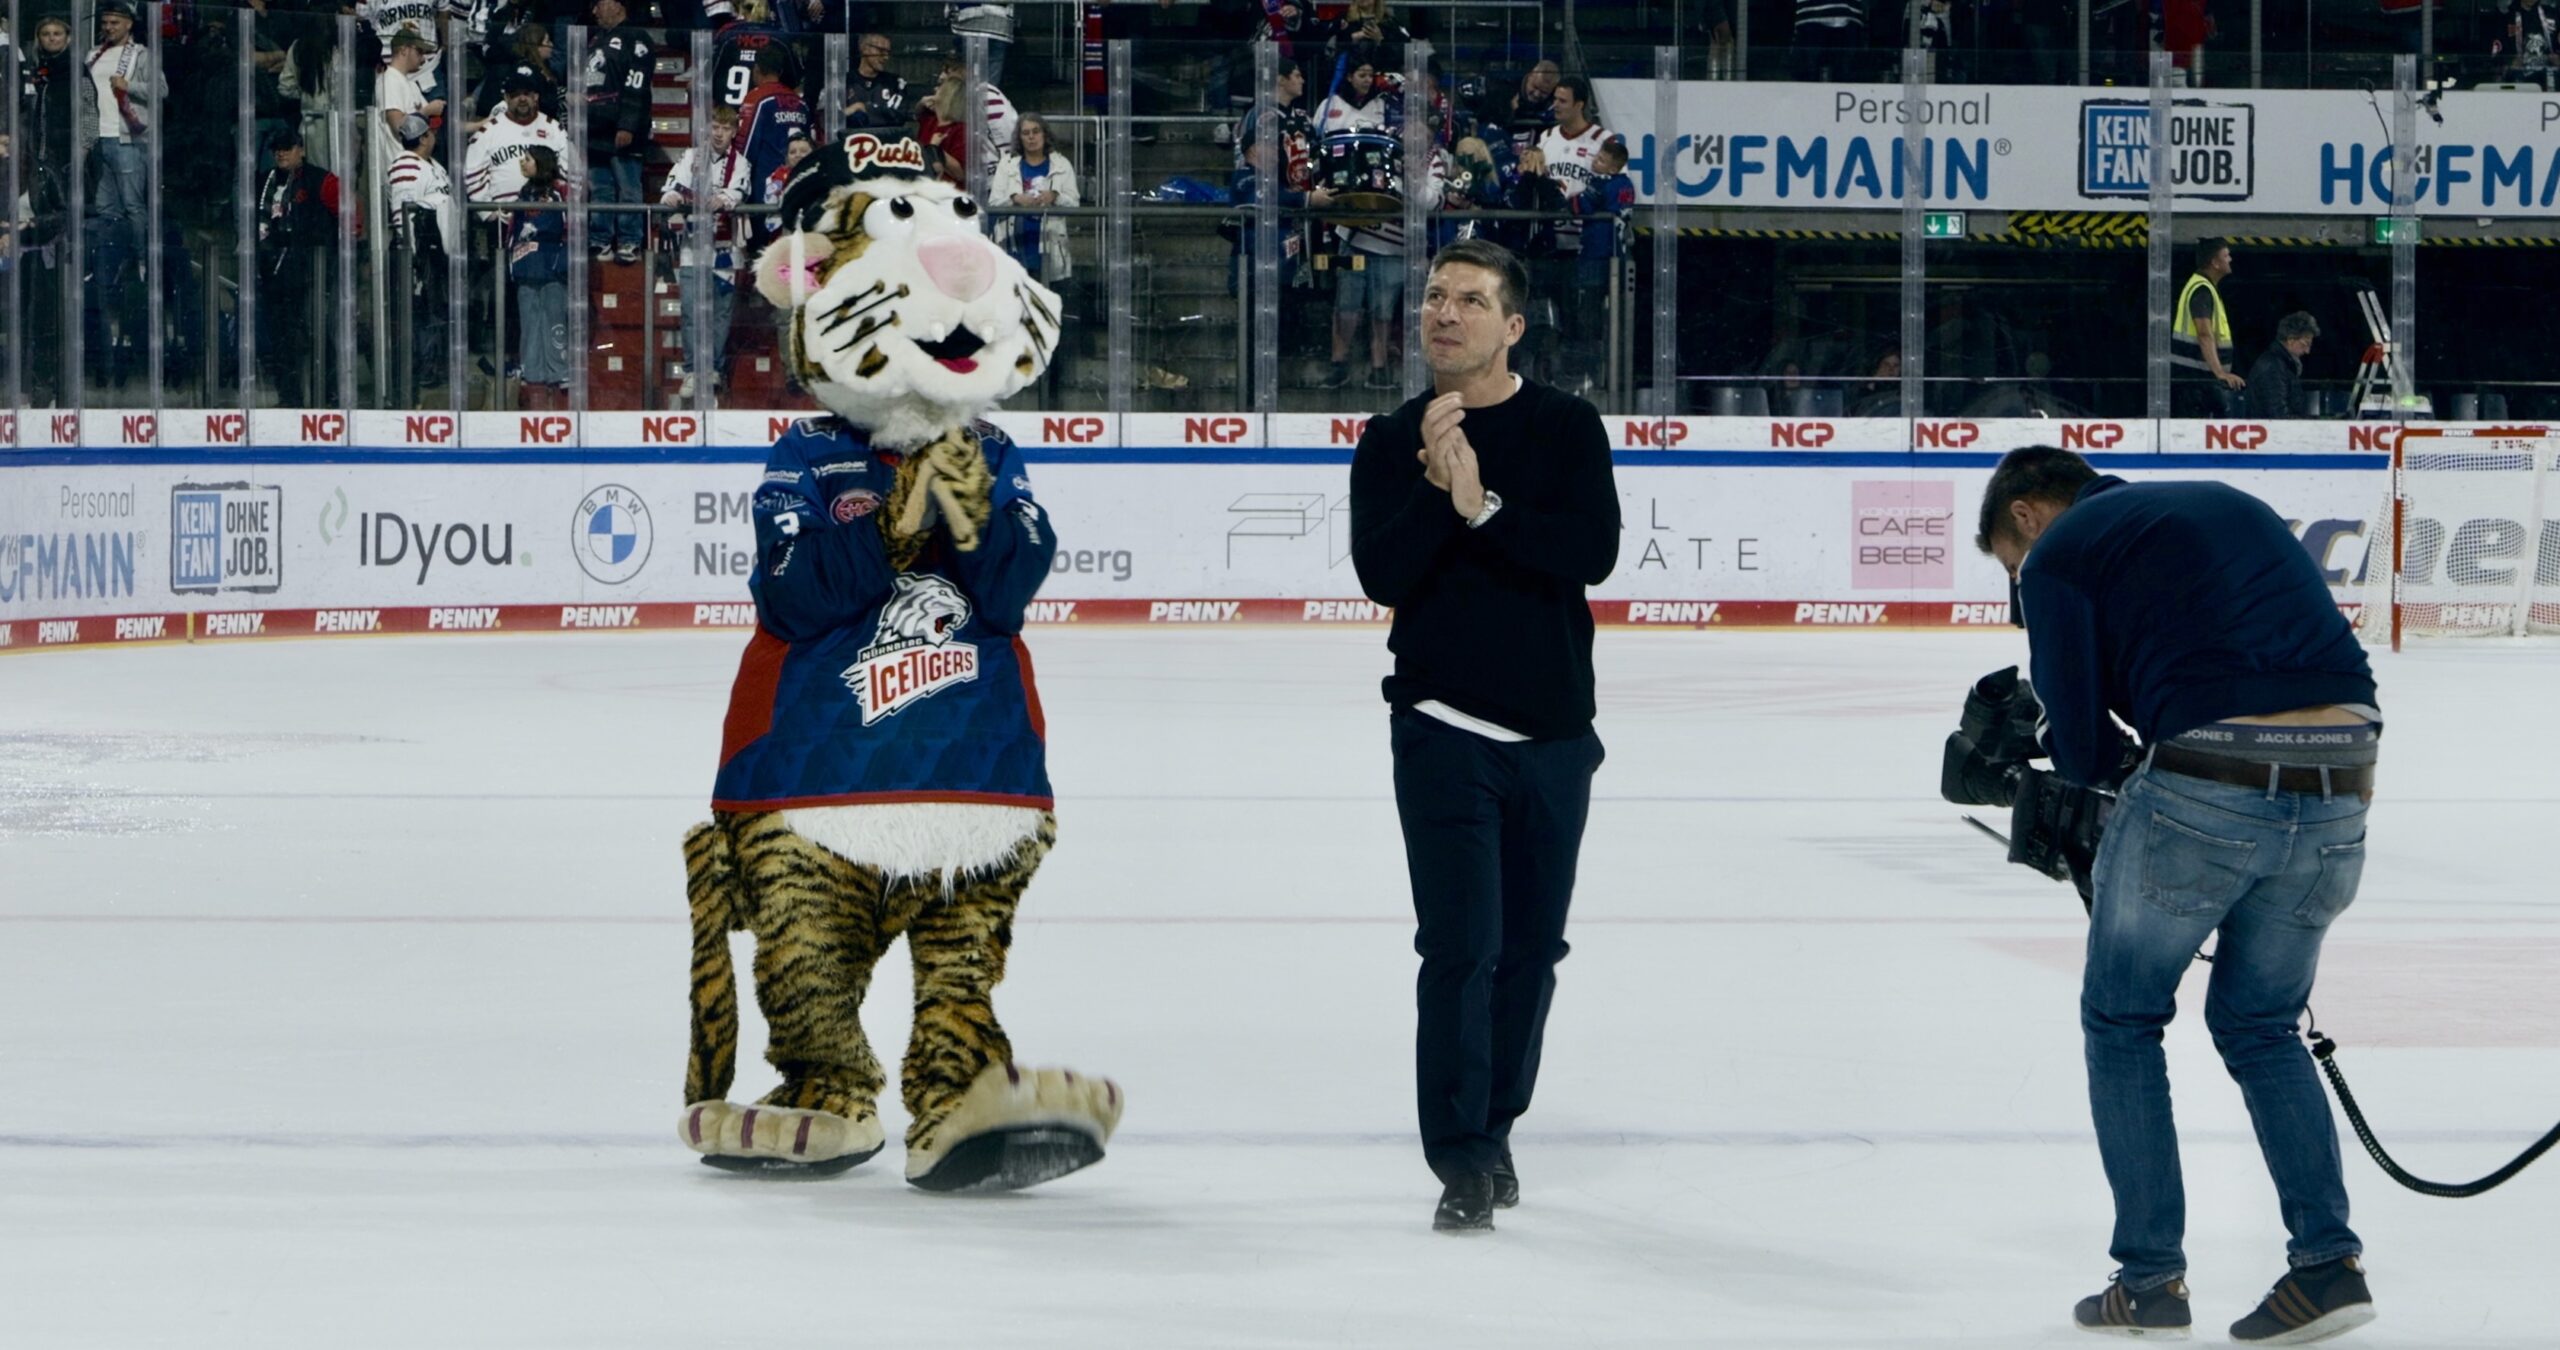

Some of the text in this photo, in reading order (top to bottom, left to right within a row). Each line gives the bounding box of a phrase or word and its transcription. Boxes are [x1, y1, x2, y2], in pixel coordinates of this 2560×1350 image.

[379, 3, 434, 29] NÜRNBER
[1836, 91, 1991, 125] Personal
[2096, 116, 2150, 146] KEIN
[2171, 116, 2235, 146] OHNE
[2096, 148, 2150, 184] FAN
[2171, 149, 2241, 185] JOB.
[123, 415, 156, 443] NCP
[206, 415, 245, 442] NCP
[301, 414, 345, 442] NCP
[405, 416, 454, 443] NCP
[520, 416, 572, 443] NCP
[642, 416, 697, 443] NCP
[1043, 418, 1104, 443] NCP
[1185, 418, 1248, 443] NCP
[1625, 421, 1689, 446] NCP
[1771, 422, 1835, 447] NCP
[1916, 422, 1980, 448] NCP
[2062, 424, 2124, 449] NCP
[2206, 424, 2268, 449] NCP
[2350, 426, 2398, 450] NC
[61, 482, 135, 518] Personal
[583, 489, 641, 516] BMW
[694, 492, 750, 525] BM
[180, 502, 216, 533] KEIN
[226, 501, 269, 533] OHNE
[180, 538, 216, 577] FAN
[226, 537, 273, 576] JOB.
[1859, 546, 1945, 565] BEER
[692, 604, 758, 625] PENN
[861, 637, 925, 662] NÜRNBERG
